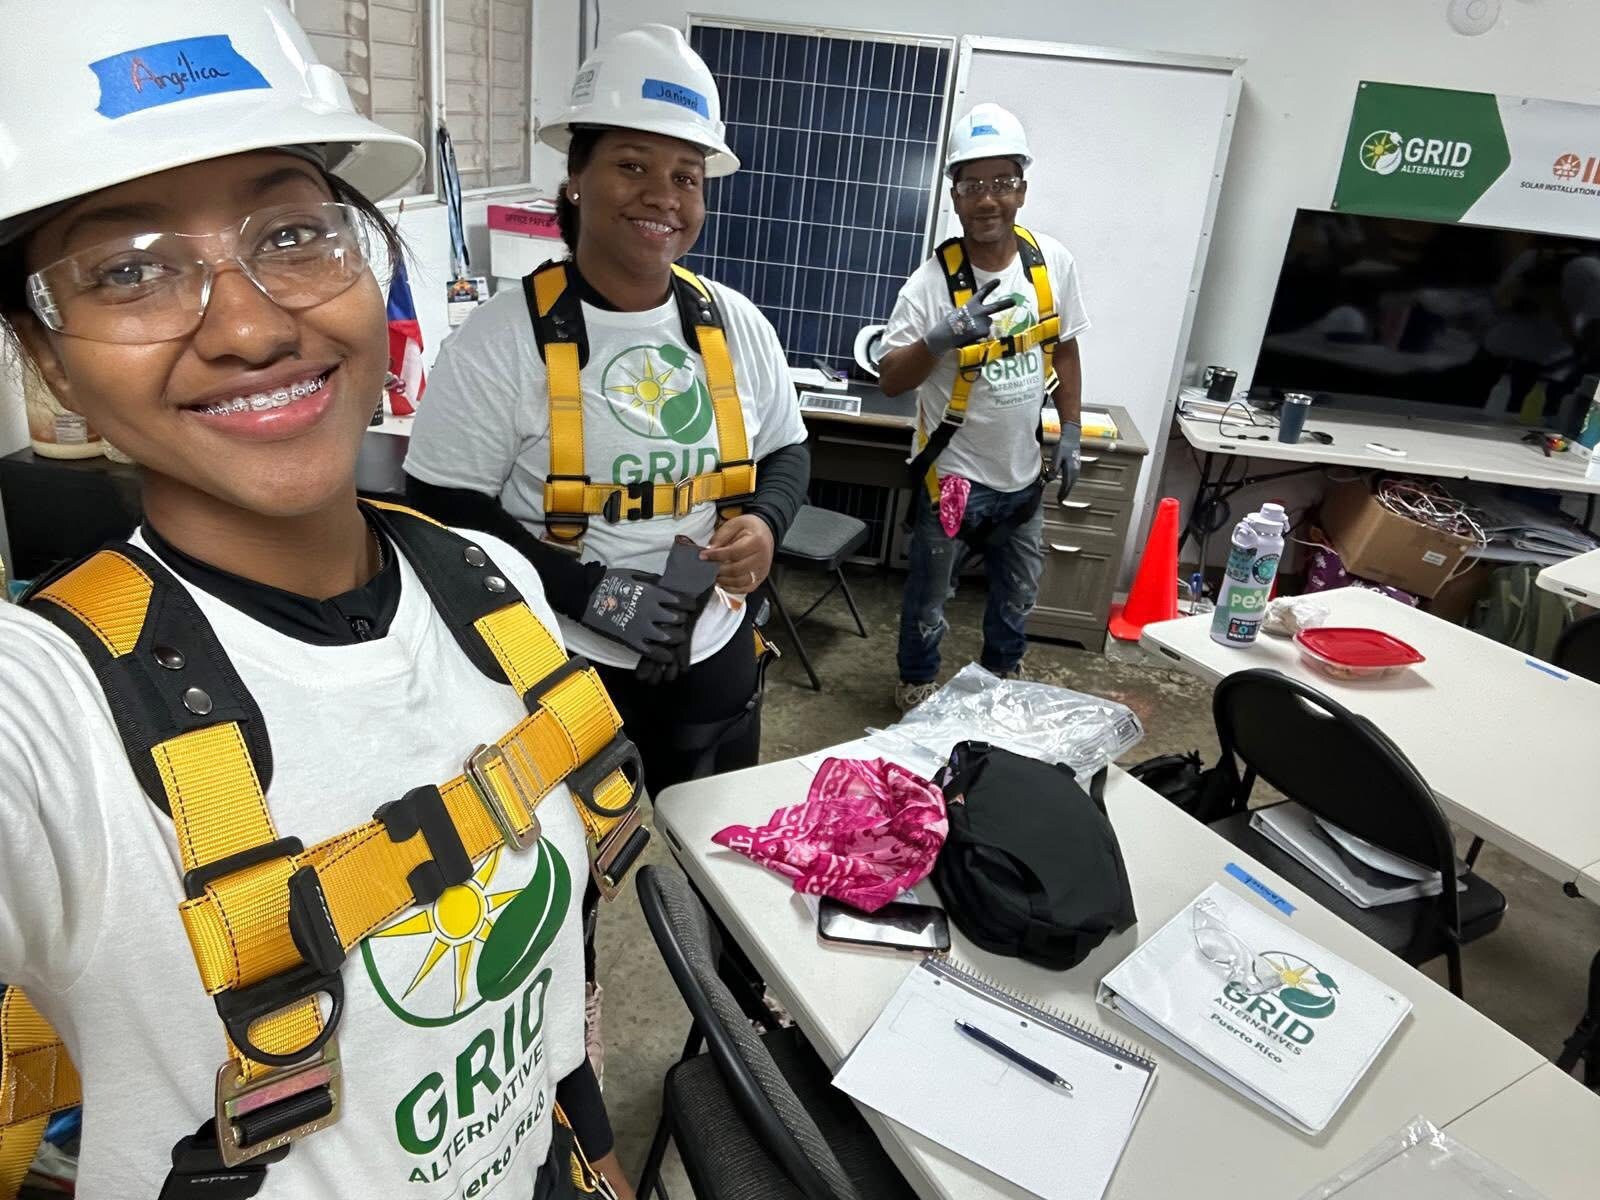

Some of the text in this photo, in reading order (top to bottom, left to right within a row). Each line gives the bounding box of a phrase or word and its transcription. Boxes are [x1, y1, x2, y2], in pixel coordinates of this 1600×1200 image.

[1400, 164, 1465, 178] ALTERNATIVES
[1404, 137, 1472, 168] GRID
[1520, 181, 1545, 189] SOLAR
[1545, 183, 1595, 196] INSTALLATION
[986, 351, 1038, 381] GRID
[612, 447, 719, 486] GRID
[1213, 997, 1303, 1056] ALTERNATIVES
[1223, 980, 1315, 1045] GRID
[395, 967, 553, 1155] GRID
[1211, 1013, 1283, 1064] Puerto Rico
[408, 1040, 543, 1184] ALTERNATIVE
[462, 1090, 545, 1199] erto Rico
